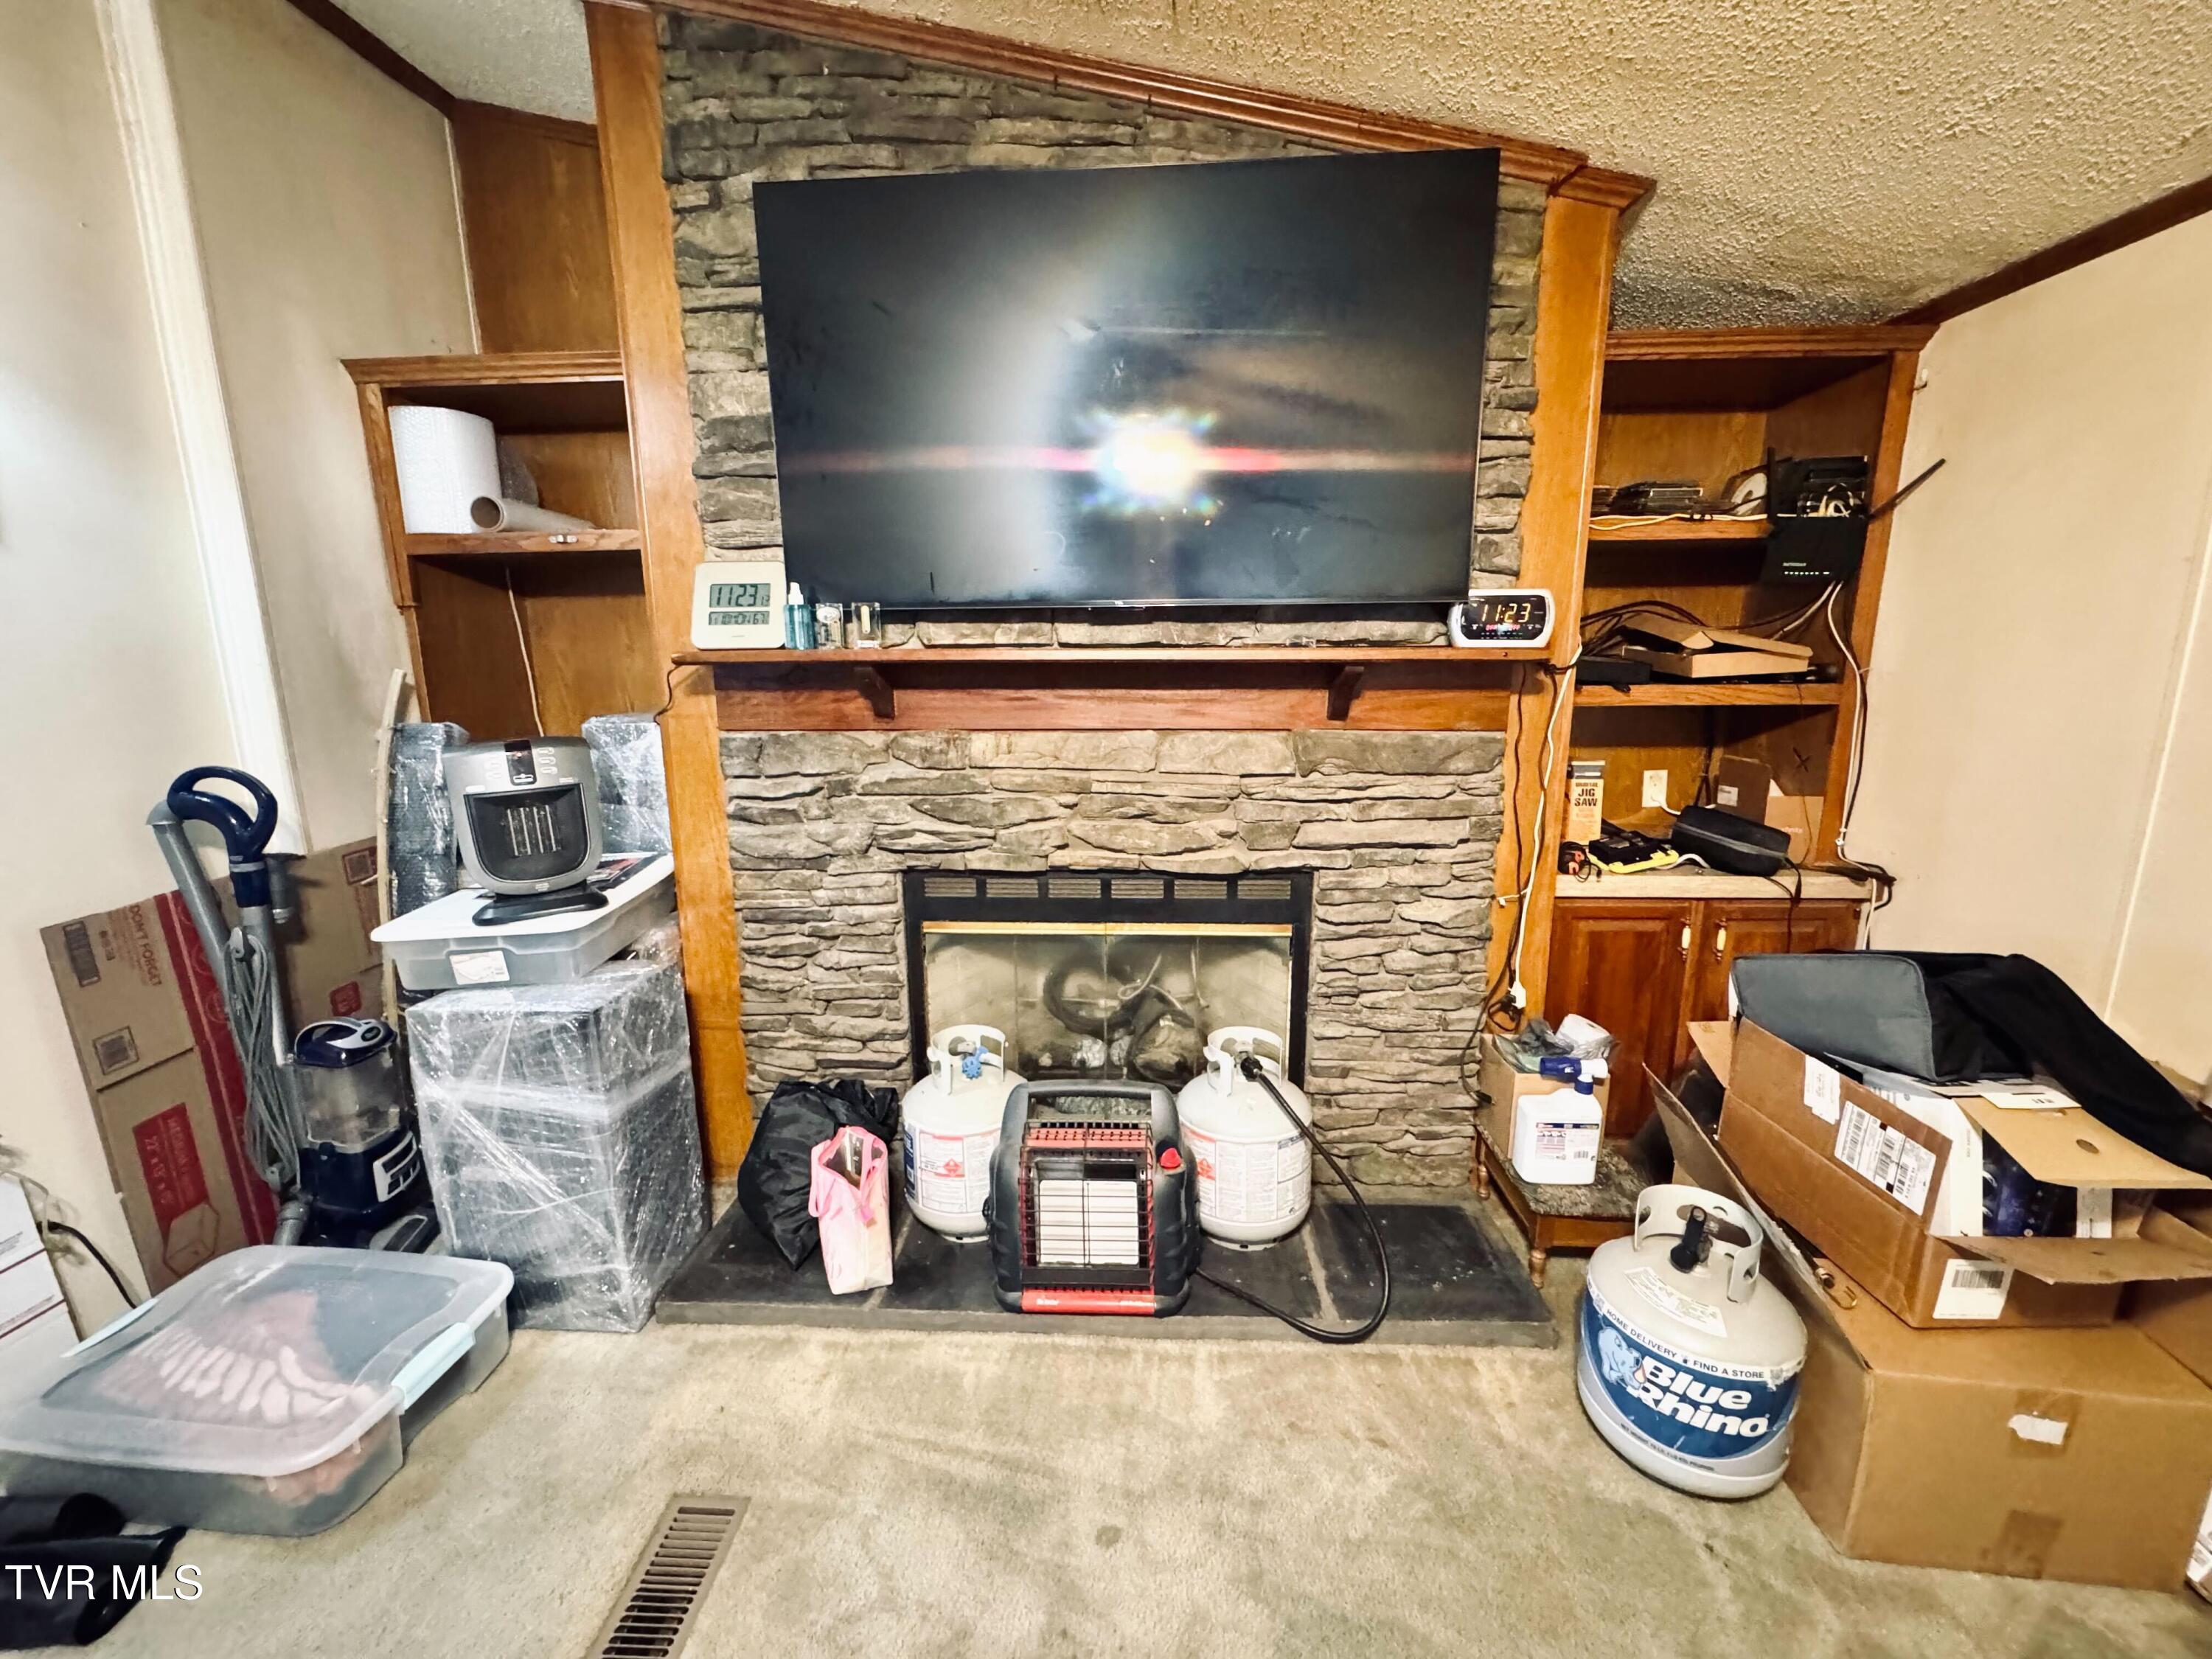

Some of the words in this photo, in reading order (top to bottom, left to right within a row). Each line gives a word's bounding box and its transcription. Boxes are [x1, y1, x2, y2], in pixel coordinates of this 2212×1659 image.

[1481, 602, 1531, 623] 11:23
[1574, 798, 1598, 807] SAW
[1578, 788, 1596, 797] JIG
[140, 942, 162, 986] FORGET
[1607, 1310, 1629, 1332] HOME
[1630, 1329, 1677, 1358] DELIVERY
[1694, 1360, 1718, 1373] FIND
[1733, 1370, 1764, 1379] STORE
[1641, 1356, 1752, 1410] Blue
[1626, 1383, 1769, 1438] Rhino
